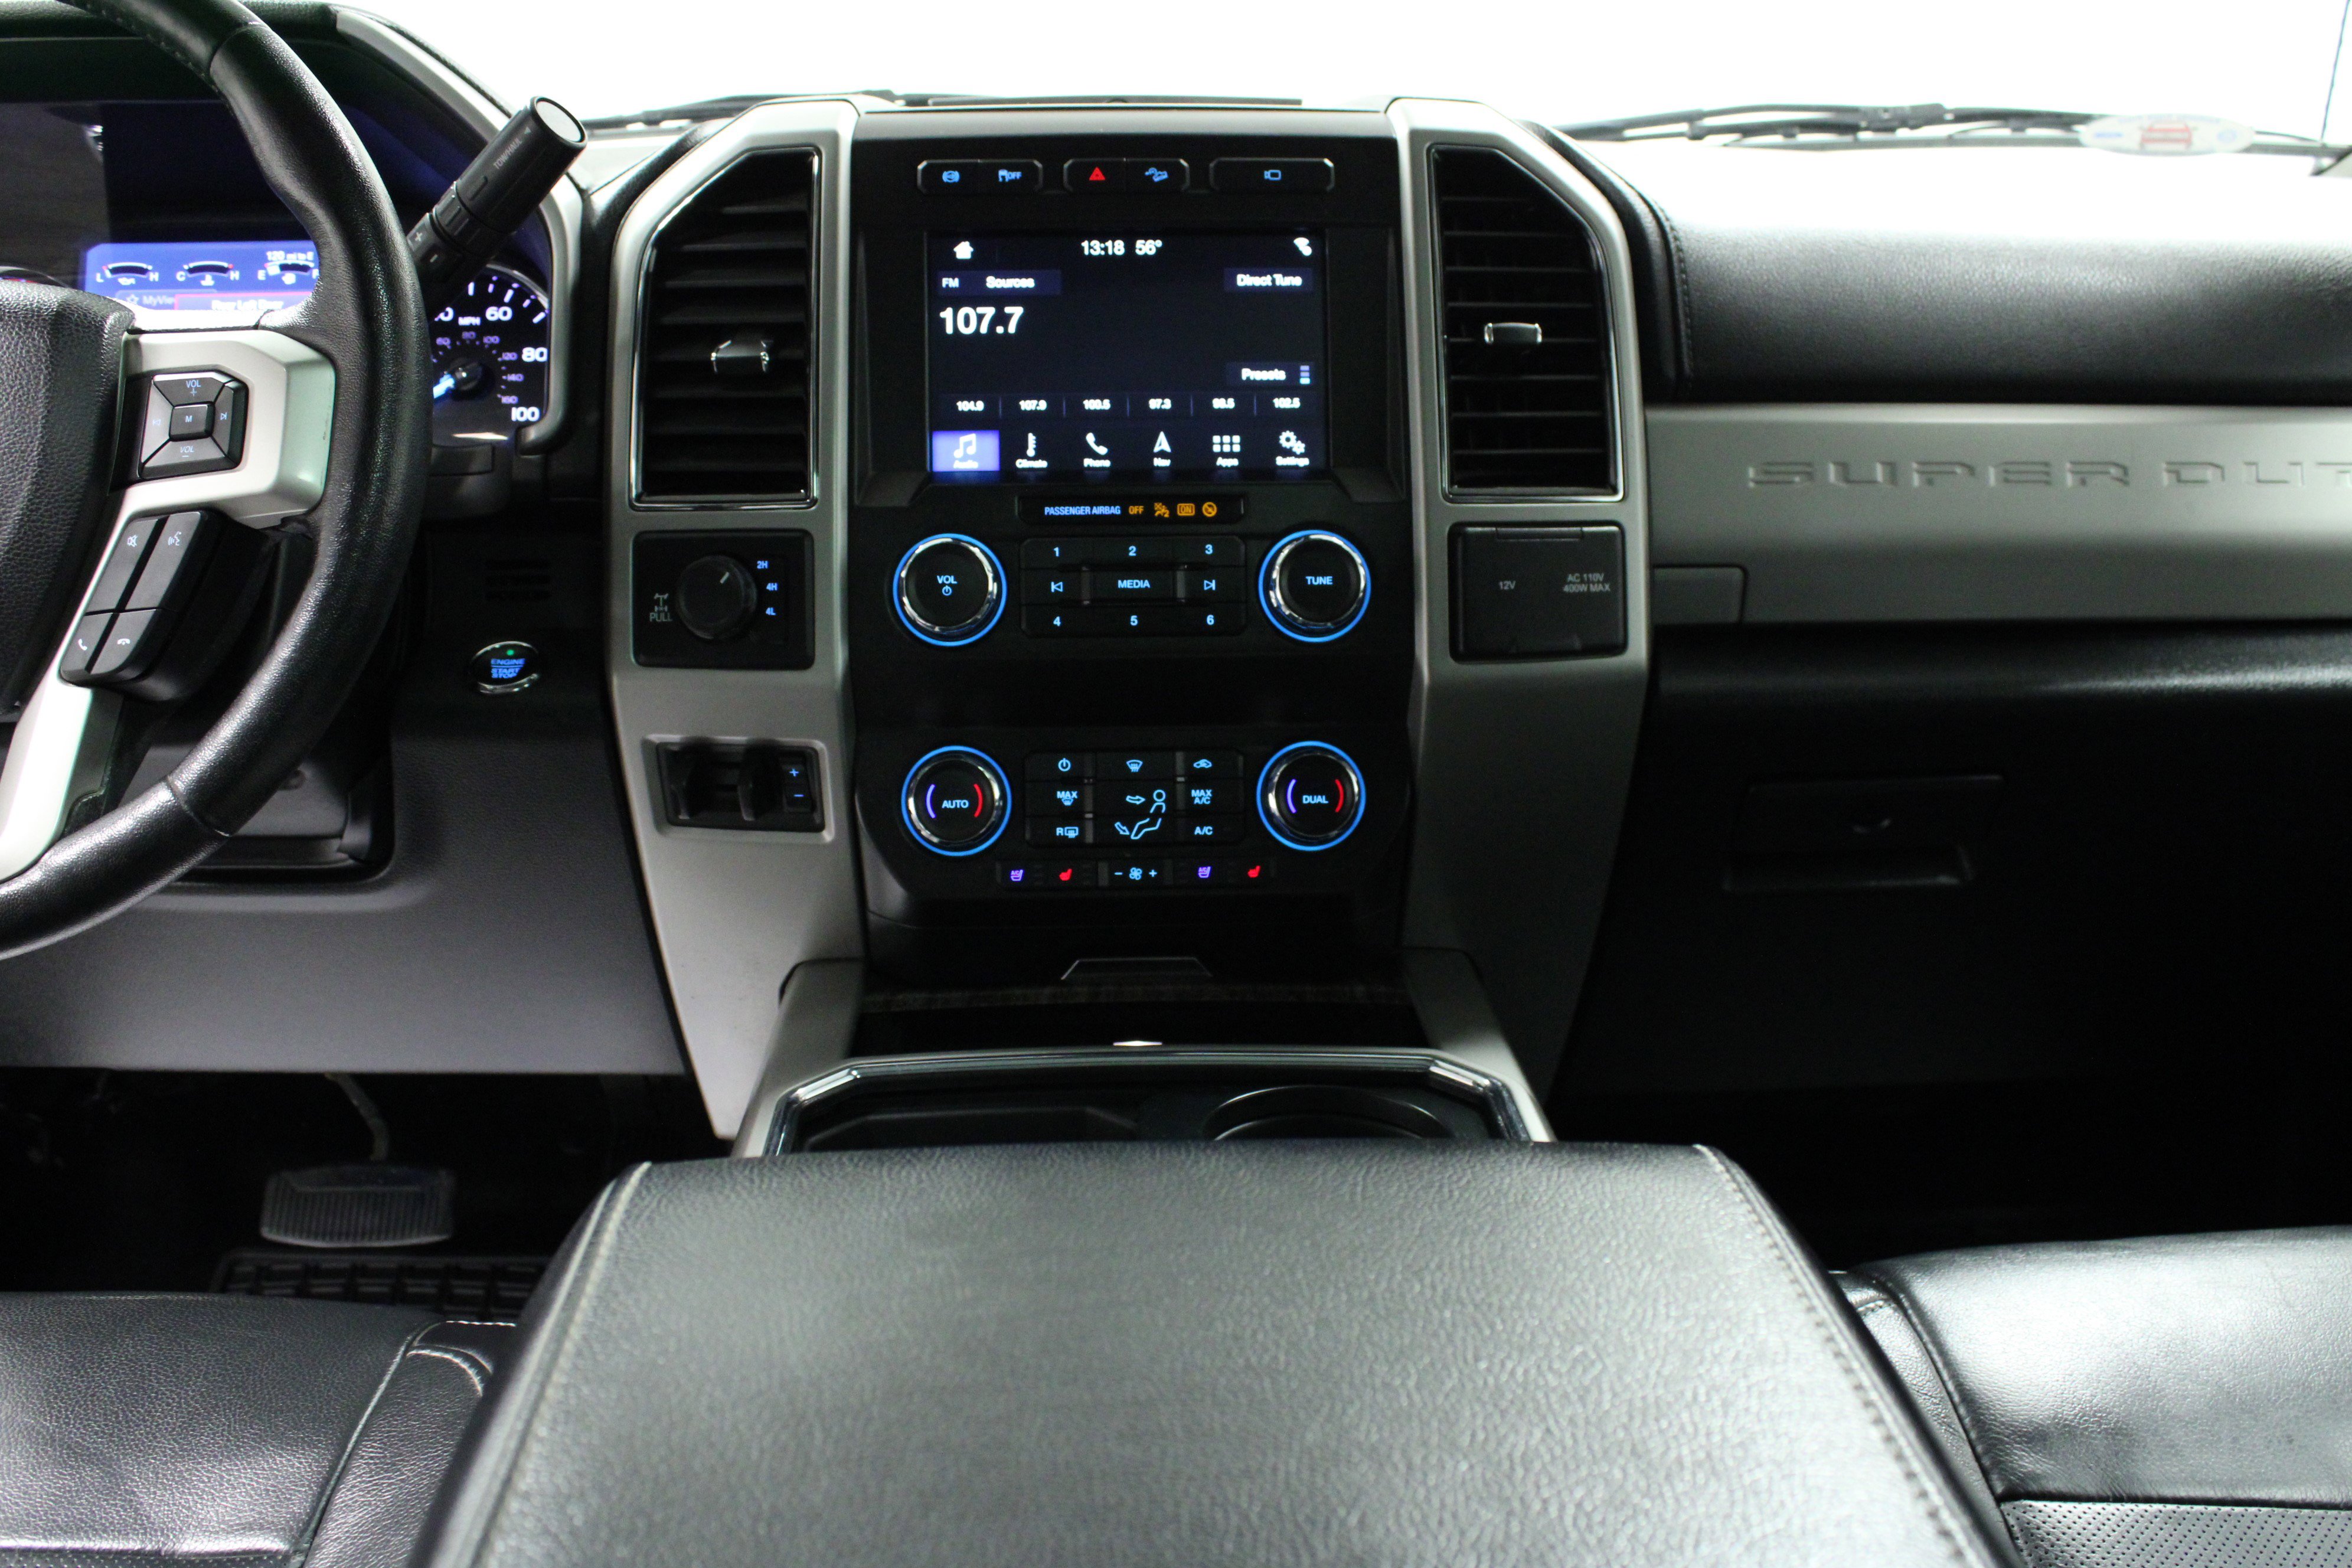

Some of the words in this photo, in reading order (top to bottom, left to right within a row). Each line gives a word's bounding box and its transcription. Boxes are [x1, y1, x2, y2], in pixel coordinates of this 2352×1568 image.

[1008, 171, 1022, 179] OFF
[1080, 239, 1125, 256] 13:18
[266, 250, 285, 261] 120
[96, 273, 104, 283] L
[148, 272, 159, 282] H
[230, 271, 240, 281] H
[257, 270, 266, 280] E
[1237, 273, 1272, 287] Direct
[1273, 273, 1303, 287] Tune
[942, 277, 960, 289] FM
[985, 275, 1035, 289] Sources
[485, 306, 512, 322] 60
[458, 316, 481, 325] MPH
[939, 306, 1024, 335] 107.7
[483, 335, 500, 344] 100
[521, 347, 548, 362] 80
[1241, 368, 1286, 381] Presets
[185, 380, 201, 388] VOL
[956, 400, 985, 412] 104.9
[1018, 399, 1047, 411] 107.9
[1082, 398, 1111, 410] 100.5
[511, 406, 540, 422] 100
[1015, 458, 1048, 469] Climate
[1083, 458, 1112, 468] Phone
[1153, 457, 1171, 467] Nav
[1216, 456, 1239, 468] Apps
[1275, 456, 1310, 468] Settings
[1747, 460, 2130, 489] SUPER
[1044, 505, 1091, 516] PASSENGER
[1092, 505, 1121, 515] AIRBAG
[1128, 505, 1144, 515] OFF
[1053, 547, 1060, 557] 1
[1128, 545, 1137, 557] 2
[1205, 544, 1213, 555] 3
[756, 560, 769, 570] 2H
[936, 574, 958, 584] VOL
[1305, 576, 1334, 586] TUNE
[1567, 573, 1580, 582] AC
[1583, 573, 1605, 582] 110V
[766, 582, 779, 592] 4H
[1118, 579, 1151, 589] MEDIA
[1499, 580, 1516, 590] 12V
[1589, 583, 1611, 592] MAX
[765, 607, 776, 616] 4L
[649, 612, 673, 622] PULL
[1053, 616, 1061, 627] 4
[1130, 615, 1138, 626] 5
[1206, 614, 1215, 626] 6
[1056, 790, 1078, 799] MAX
[1191, 789, 1213, 798] MAX
[941, 799, 970, 809] AUTO
[1193, 796, 1211, 805] A/C
[1302, 795, 1329, 804] DUAL
[1056, 827, 1064, 836] R
[1194, 826, 1213, 835] A/C
